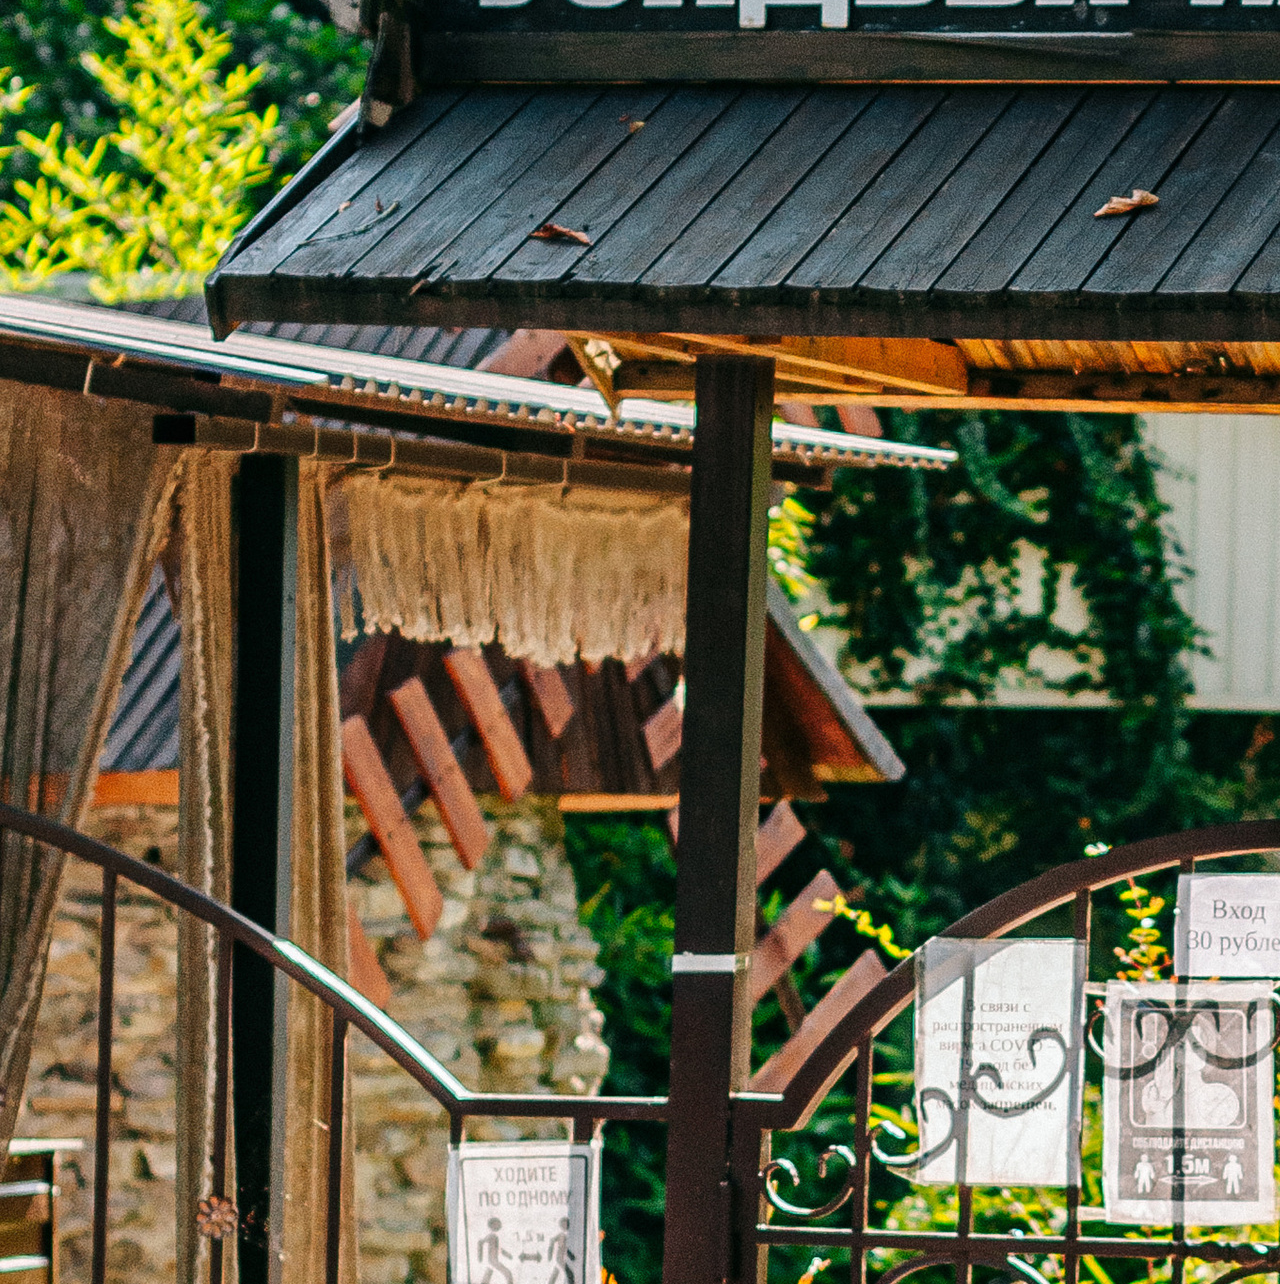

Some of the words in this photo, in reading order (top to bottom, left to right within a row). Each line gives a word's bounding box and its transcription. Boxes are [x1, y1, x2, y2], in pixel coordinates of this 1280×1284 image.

[1212, 899, 1267, 925] Вход
[1186, 929, 1212, 950] 30
[979, 1002, 1019, 1013] связи
[1023, 1002, 1032, 1013] с
[493, 1165, 557, 1186] ХОДИТЕ
[478, 1190, 501, 1207] ПО
[505, 1190, 572, 1208] ОДНОМУ
